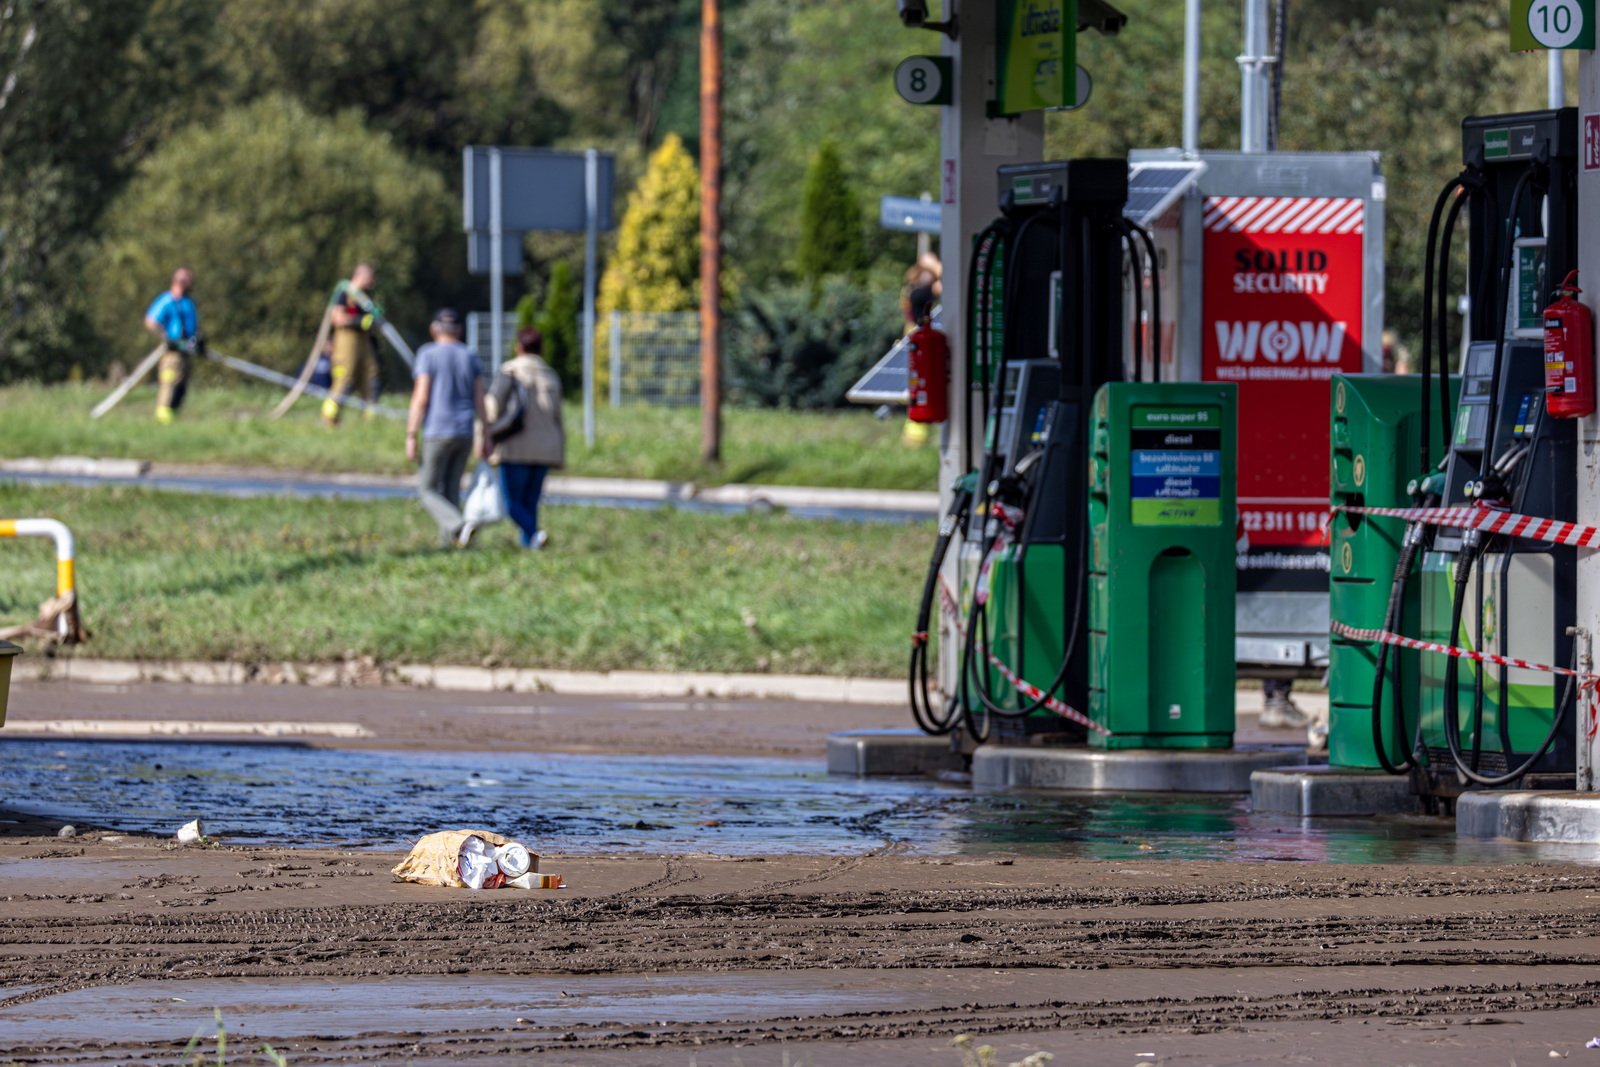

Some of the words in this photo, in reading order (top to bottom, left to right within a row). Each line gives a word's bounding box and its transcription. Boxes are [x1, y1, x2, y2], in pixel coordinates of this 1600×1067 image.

[1537, 5, 1571, 33] 10
[910, 67, 927, 92] 8
[1235, 250, 1328, 272] SOLID
[1233, 273, 1328, 294] SECURITY
[1215, 320, 1347, 362] WOW
[1146, 413, 1169, 422] euro
[1170, 413, 1196, 423] super
[1164, 434, 1193, 445] diesel
[1164, 477, 1192, 486] diesel
[1158, 509, 1197, 517] ACTIVE
[1242, 511, 1263, 531] 22
[1264, 511, 1294, 531] 311
